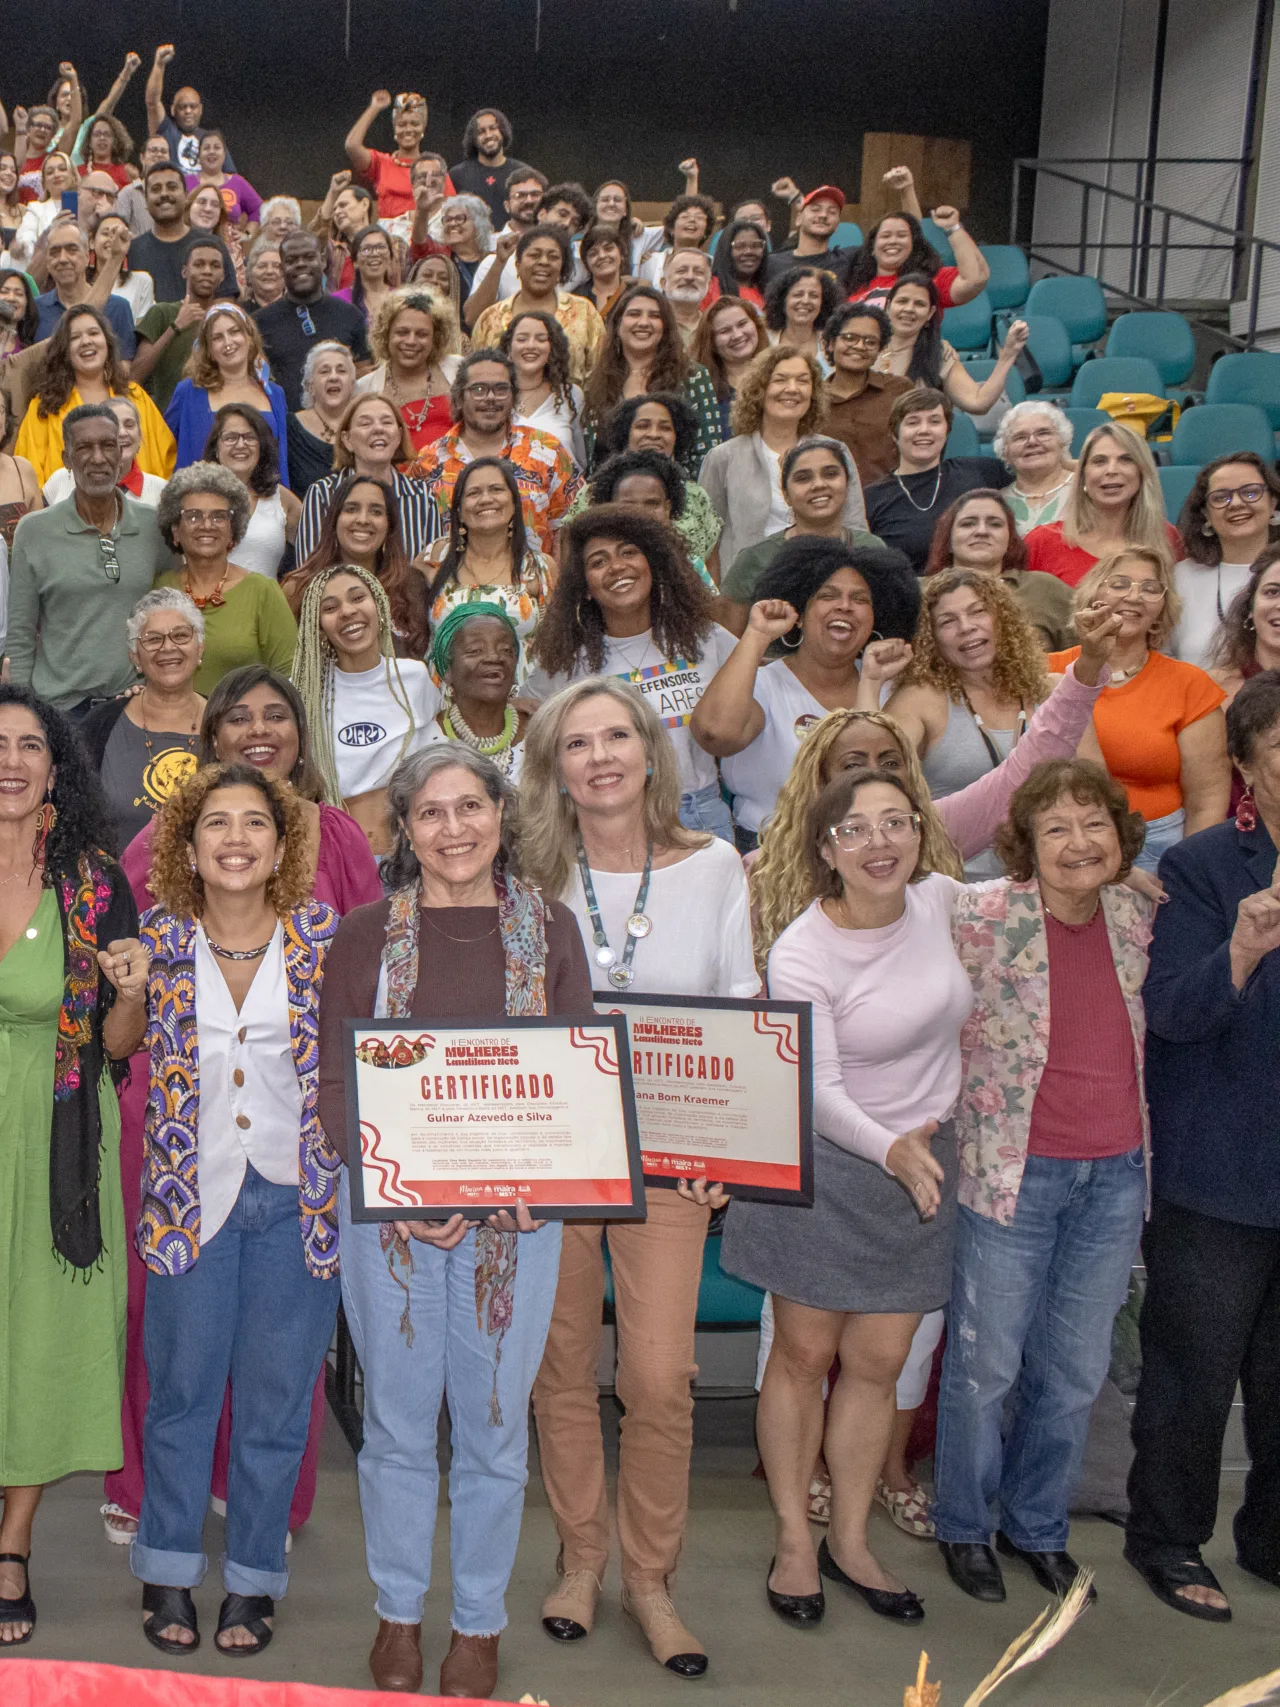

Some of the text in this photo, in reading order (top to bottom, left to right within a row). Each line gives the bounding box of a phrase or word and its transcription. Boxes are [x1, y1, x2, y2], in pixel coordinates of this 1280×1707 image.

[656, 686, 704, 715] ARES
[345, 724, 380, 745] UFRJ
[686, 1018, 696, 1026] DE
[633, 1023, 703, 1038] MULHERES
[500, 1037, 511, 1045] DE
[681, 1037, 703, 1046] Neto
[445, 1045, 519, 1058] MULHERES
[497, 1057, 519, 1066] Neto
[633, 1050, 735, 1082] RTIFICADO
[420, 1073, 554, 1100] CERTIFICADO
[636, 1092, 730, 1106] ana Bom Kraemer
[427, 1113, 464, 1122] Gulnar
[467, 1112, 514, 1122] Azevedo
[526, 1112, 553, 1121] Silva
